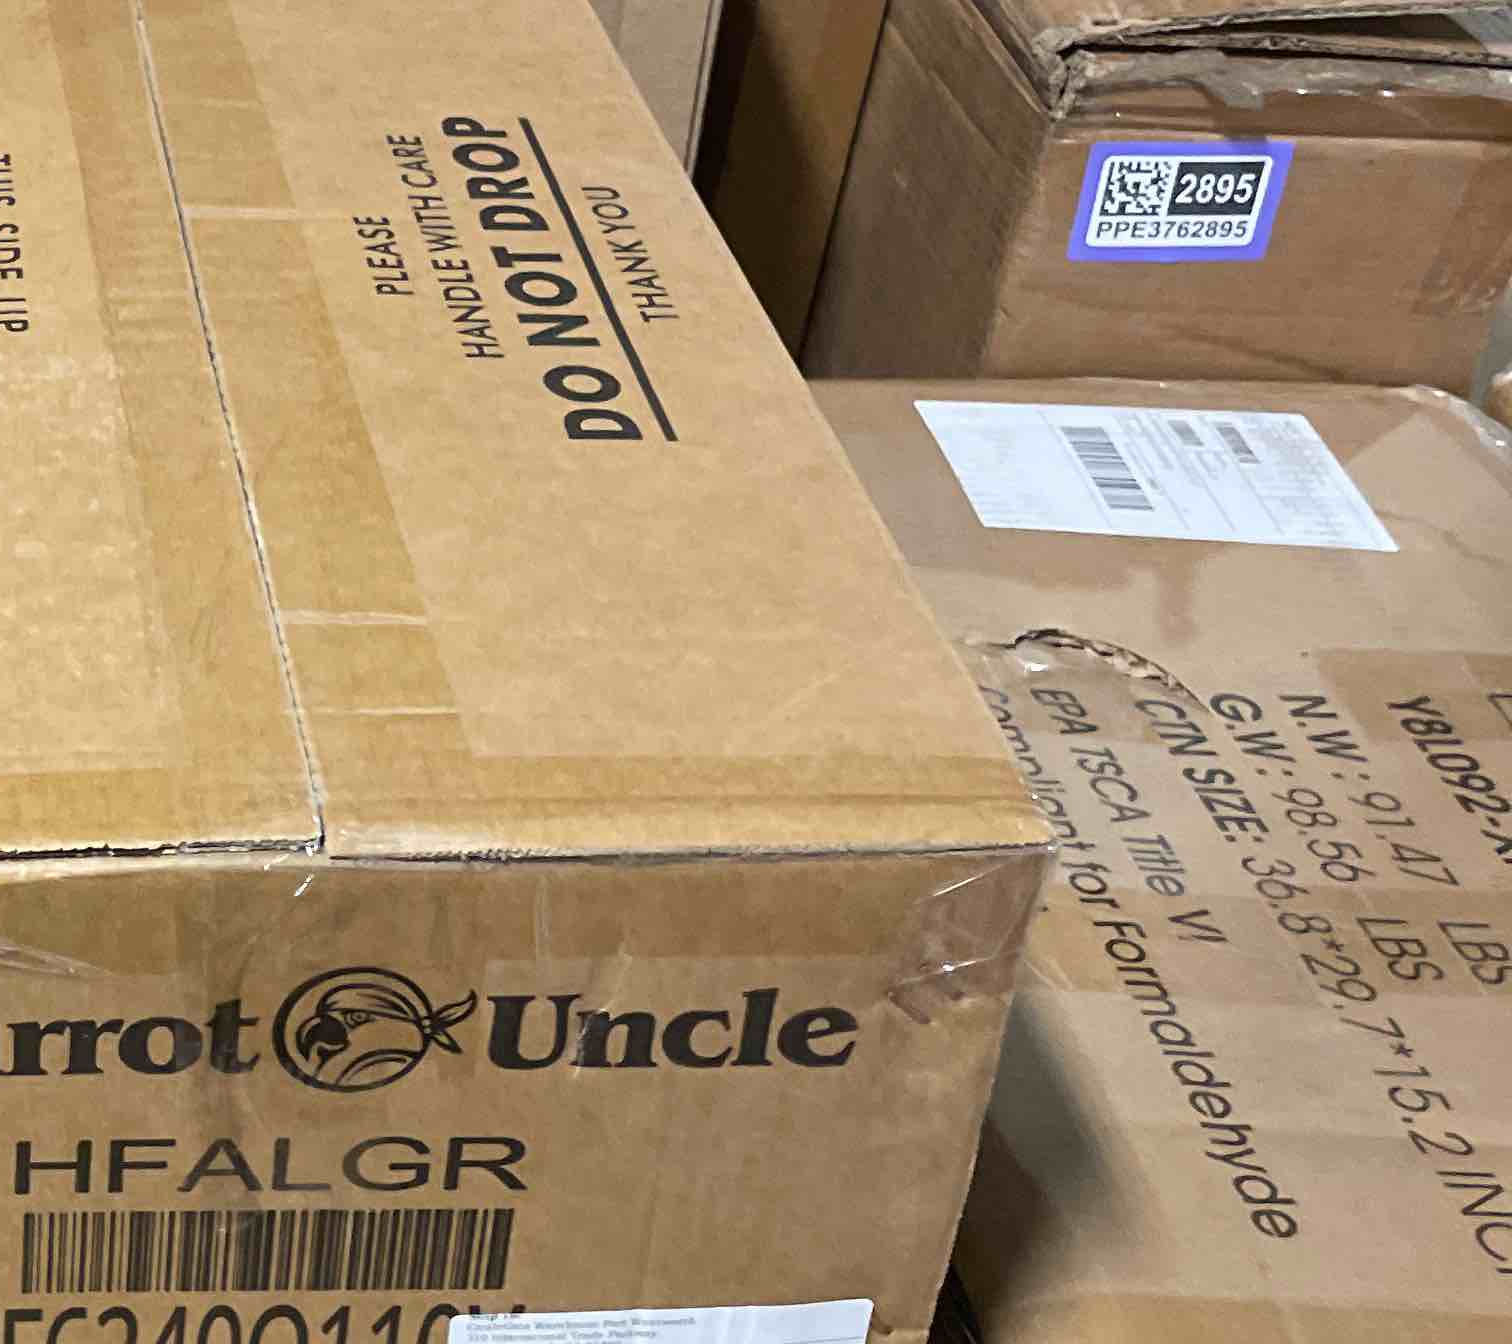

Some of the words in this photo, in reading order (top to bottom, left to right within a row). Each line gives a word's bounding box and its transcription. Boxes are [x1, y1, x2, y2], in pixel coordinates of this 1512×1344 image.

[386, 135, 438, 189] CARE
[441, 116, 550, 232] DROP
[1174, 173, 1256, 206] 2895
[408, 195, 463, 254] WITH
[581, 186, 636, 234] YOU
[1096, 219, 1249, 239] PPE3762895
[352, 215, 415, 296] PLEASE
[490, 246, 600, 347] NOT
[606, 240, 681, 323] THANK
[431, 258, 505, 358] HANDLE
[542, 364, 643, 440] DO
[1029, 687, 1099, 734] EPA
[1069, 747, 1152, 822] TSCA
[1122, 834, 1185, 897] Title
[1168, 909, 1229, 943] VI
[1272, 787, 1376, 883] 98.56
[1356, 917, 1445, 981] LBS
[1347, 791, 1460, 886] 91.47
[1438, 922, 1512, 985] LBS
[1135, 699, 1218, 757] CTN
[1183, 767, 1270, 842] SIZE:
[1436, 1171, 1512, 1274] INC
[486, 988, 860, 1070] Uncle
[1061, 862, 1120, 909] for
[1092, 919, 1299, 1240] Formaldehyde
[13, 1136, 531, 1194] HFALGR
